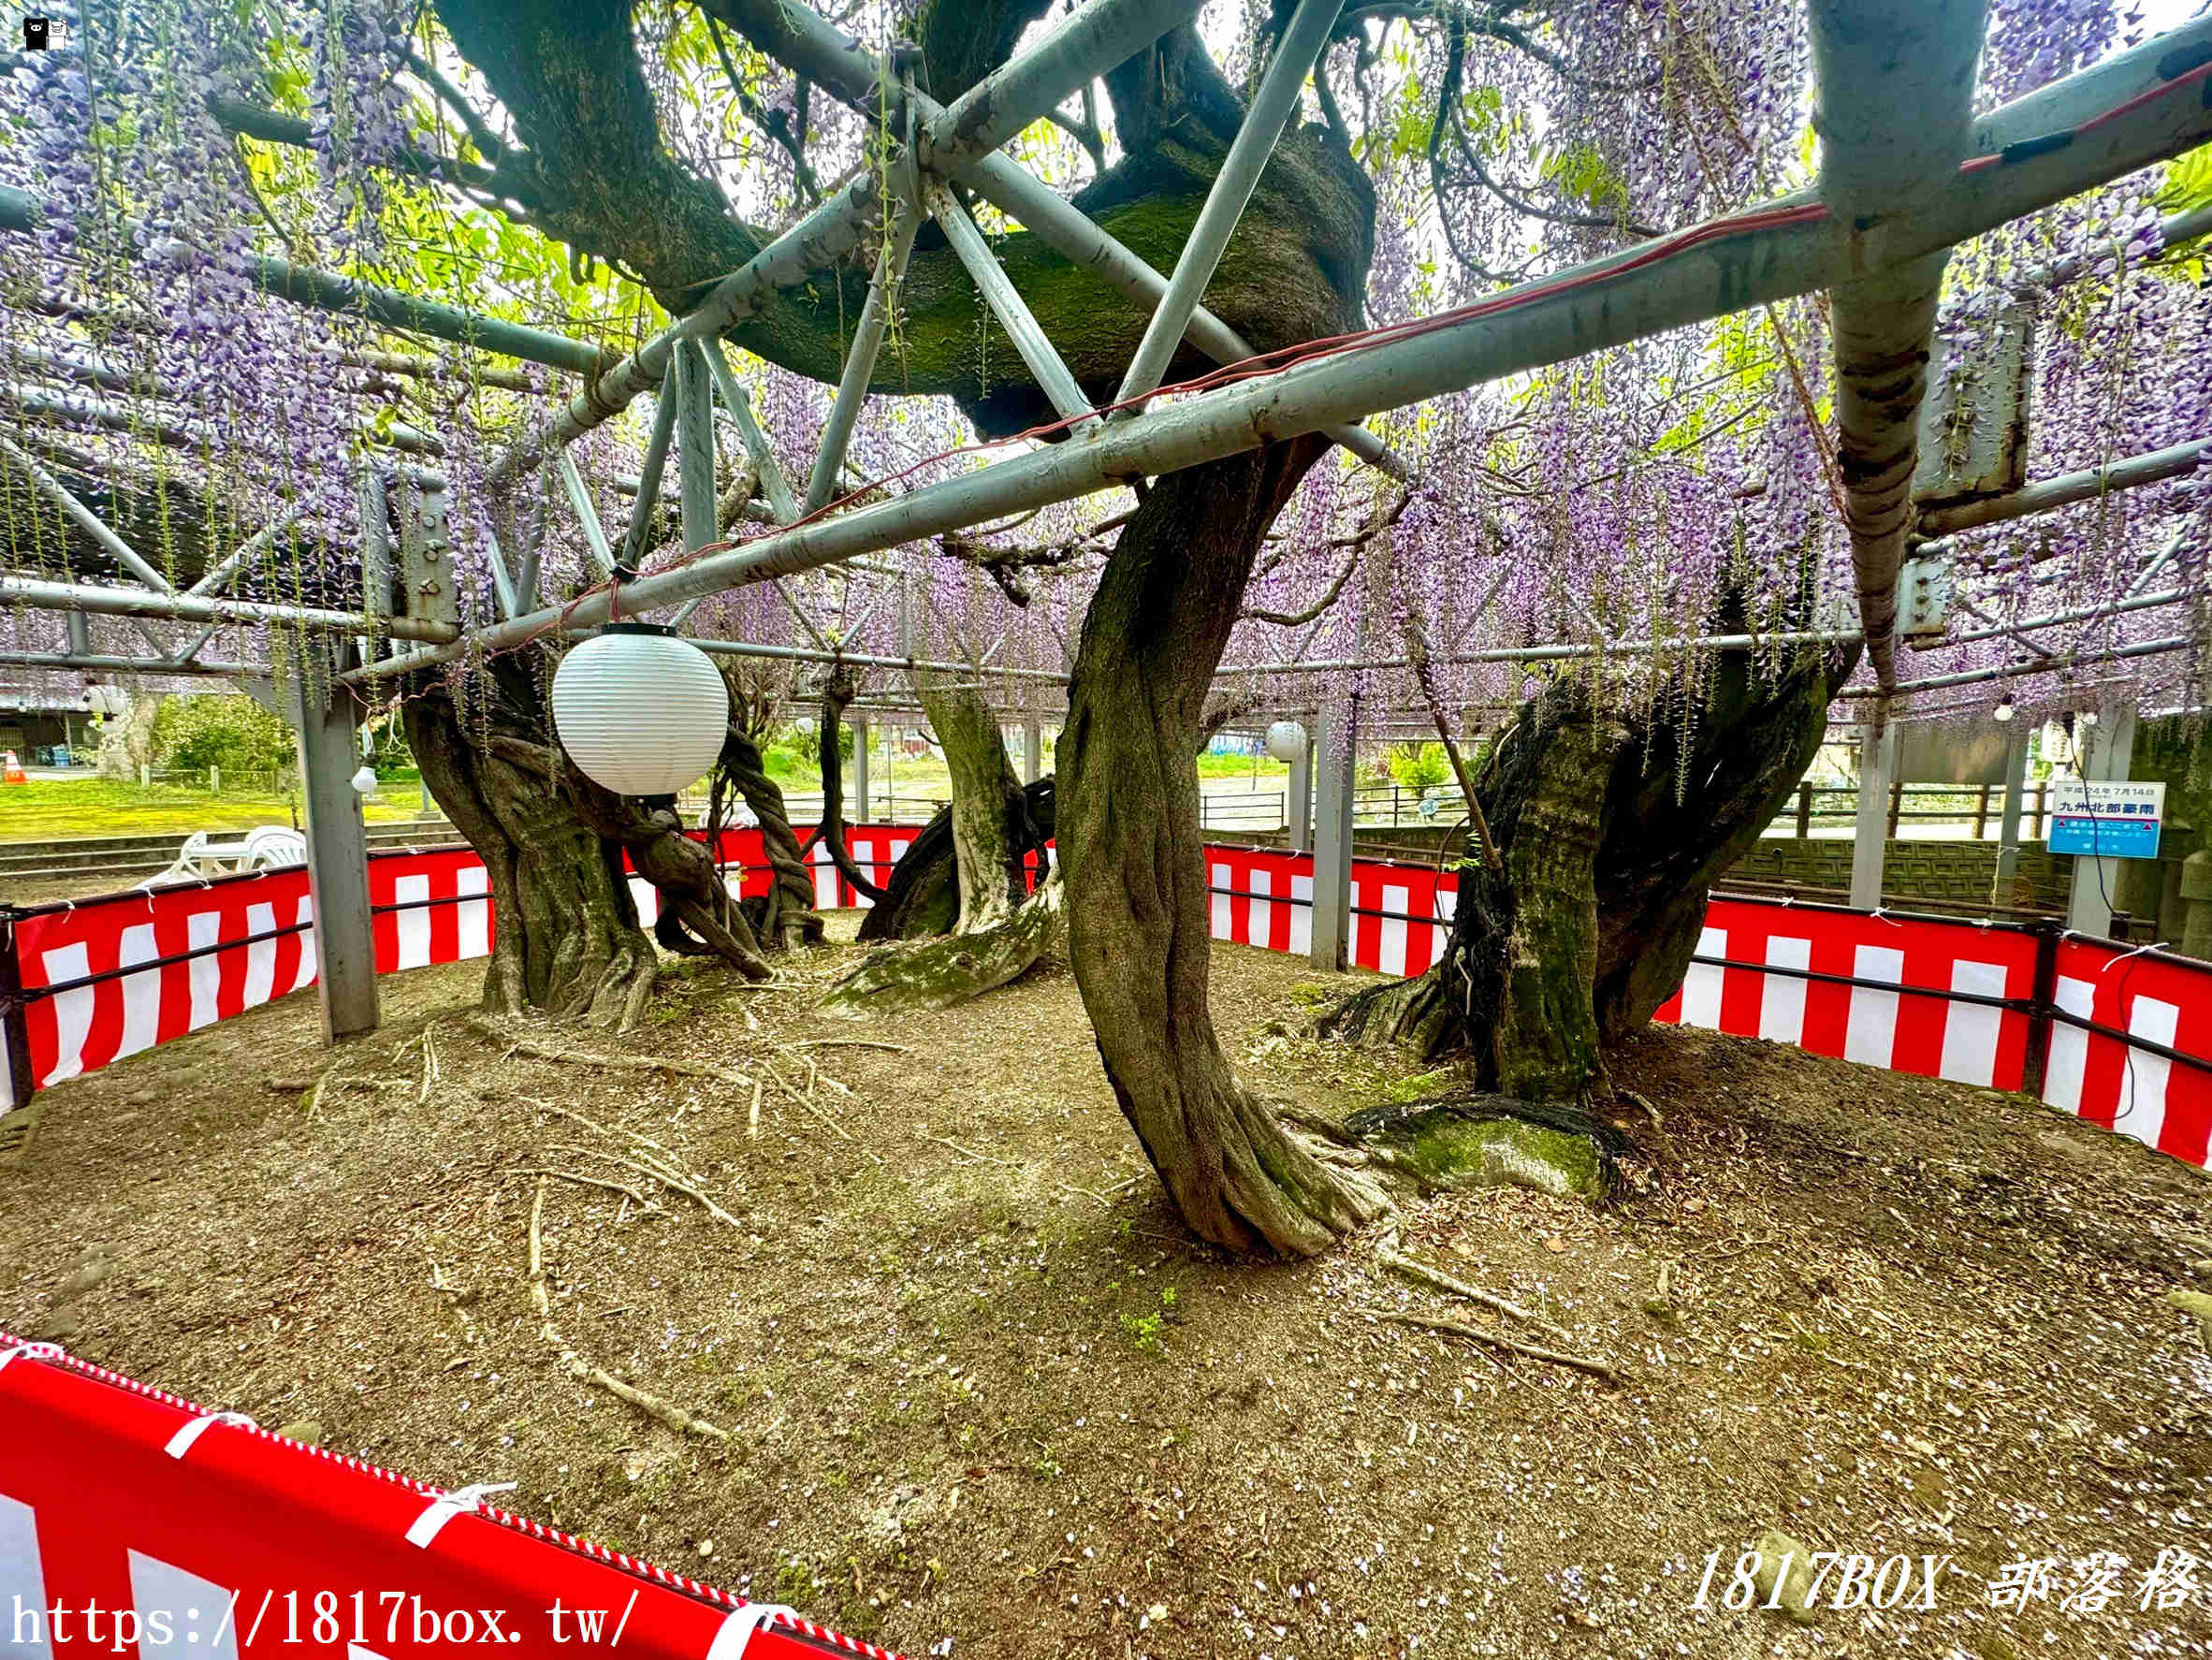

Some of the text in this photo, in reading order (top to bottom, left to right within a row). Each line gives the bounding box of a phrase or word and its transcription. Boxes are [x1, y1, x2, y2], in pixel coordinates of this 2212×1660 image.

[2059, 802, 2155, 814] 九州北部豪雨
